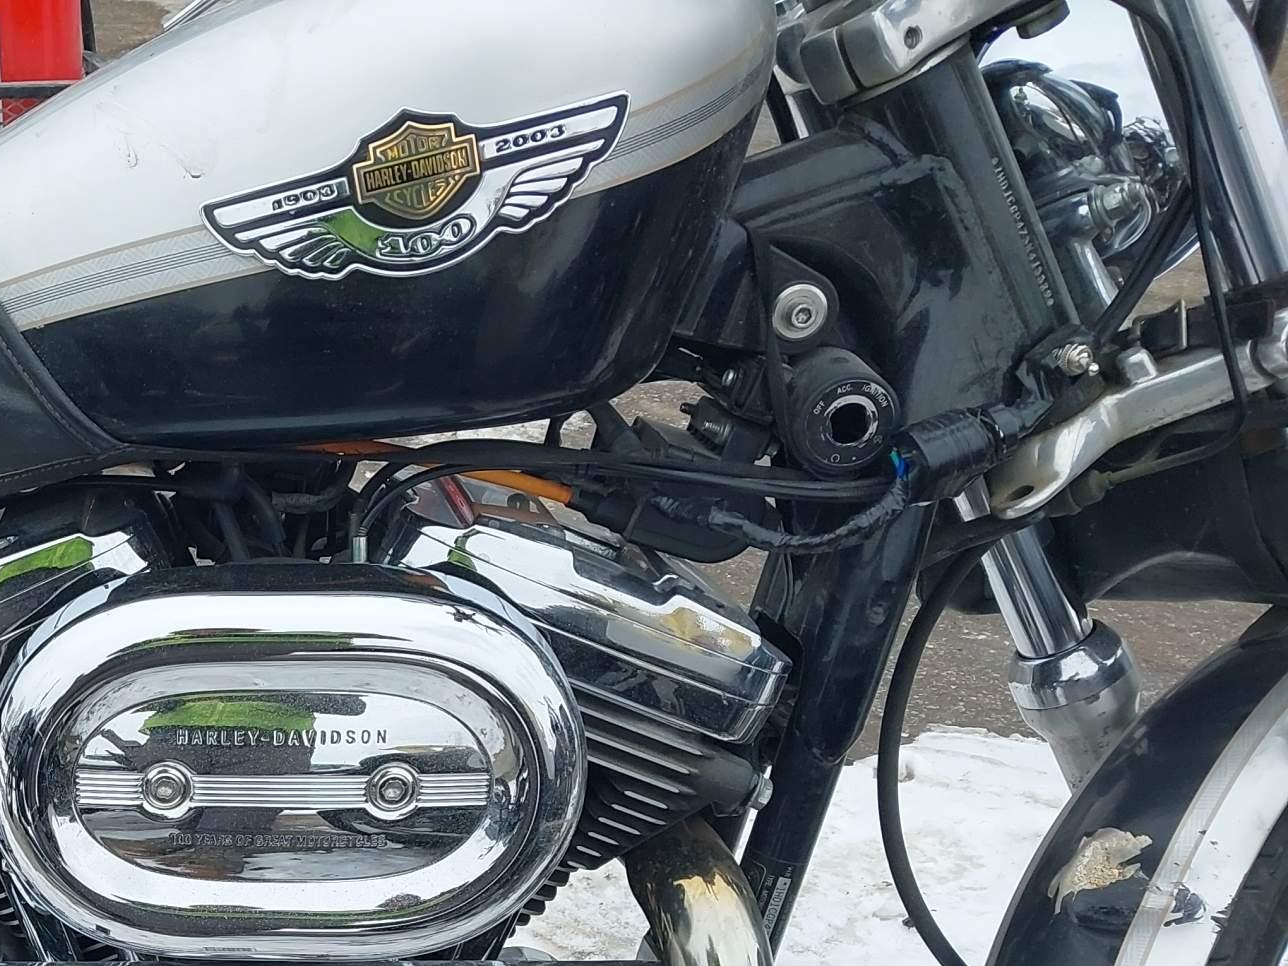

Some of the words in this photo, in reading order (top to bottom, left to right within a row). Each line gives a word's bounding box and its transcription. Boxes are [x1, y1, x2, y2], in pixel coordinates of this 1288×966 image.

[386, 133, 443, 161] MOTOR
[494, 123, 566, 154] 2003
[364, 146, 469, 193] HARLEY-DAVIDSON
[271, 186, 338, 211] 1903
[379, 213, 476, 257] 100
[813, 400, 826, 415] OFF
[862, 383, 889, 408] IGNITION
[176, 728, 388, 746] HARLEY-DAVIDSON
